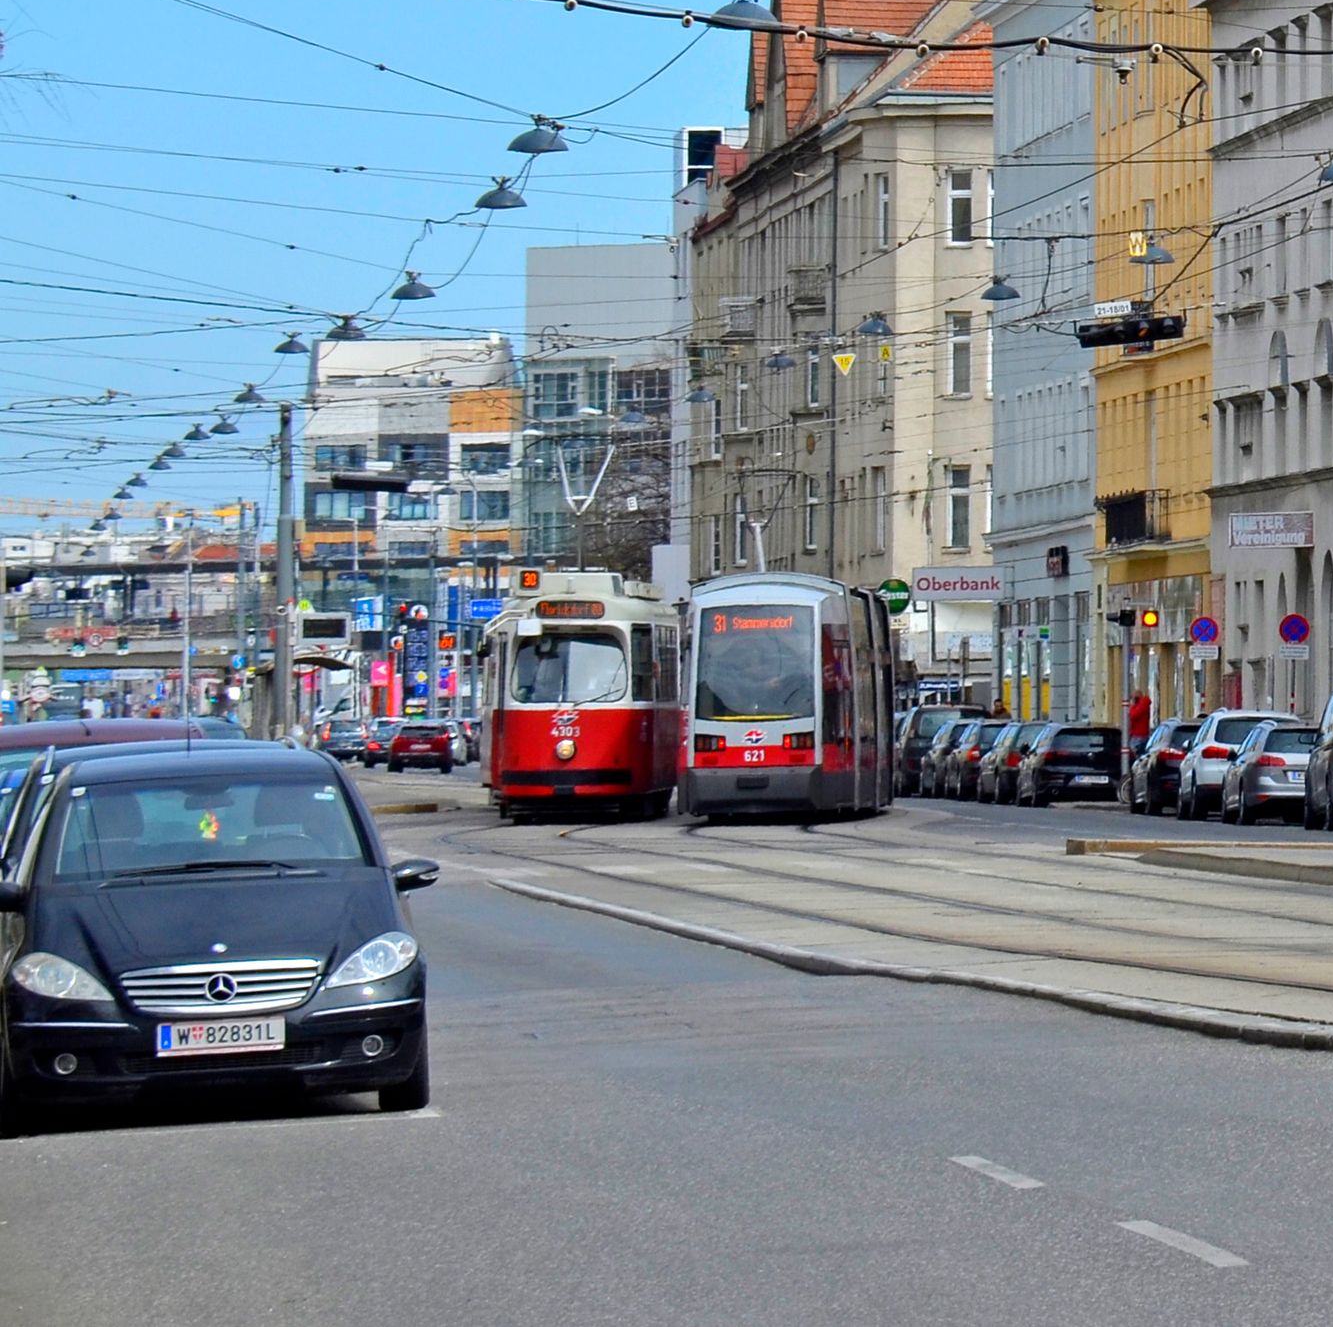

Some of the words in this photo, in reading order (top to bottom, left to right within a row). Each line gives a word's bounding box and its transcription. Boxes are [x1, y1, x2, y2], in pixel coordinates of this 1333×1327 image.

[1233, 531, 1305, 545] Vereinigung
[524, 572, 537, 587] 30
[916, 576, 1001, 592] Oberbank
[714, 615, 726, 634] 31
[551, 726, 580, 737] 4303
[744, 750, 765, 762] 621
[178, 1028, 191, 1045] W
[205, 1024, 276, 1044] 82831L
